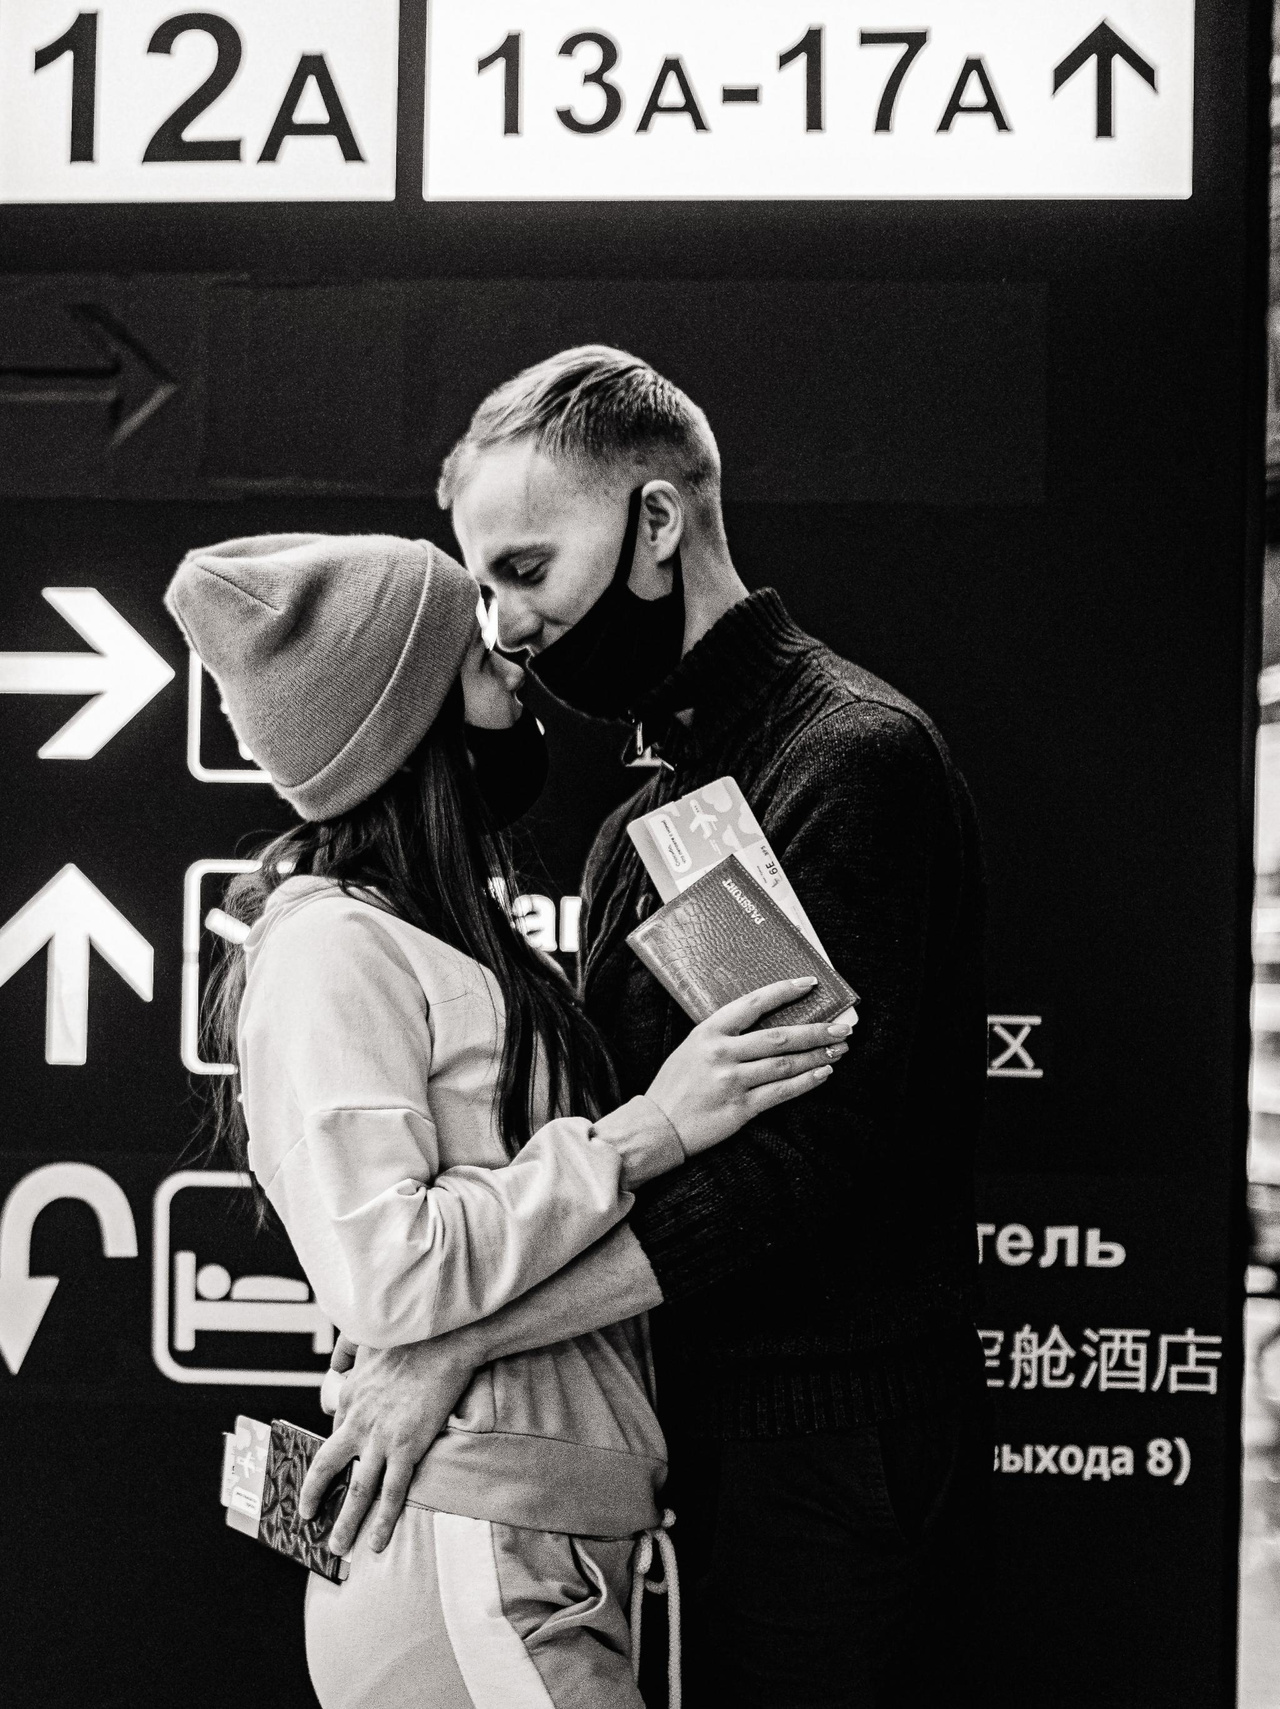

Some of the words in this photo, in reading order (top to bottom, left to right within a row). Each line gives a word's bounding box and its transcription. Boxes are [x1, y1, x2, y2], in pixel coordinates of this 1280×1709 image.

[33, 12, 366, 163] 12A
[477, 26, 1012, 136] 13A-17A
[764, 860, 779, 876] 6E
[721, 877, 766, 925] PASSPORT
[986, 1014, 1044, 1079] 区
[993, 1444, 1134, 1482] ыхода
[1146, 1437, 1192, 1487] 8)
